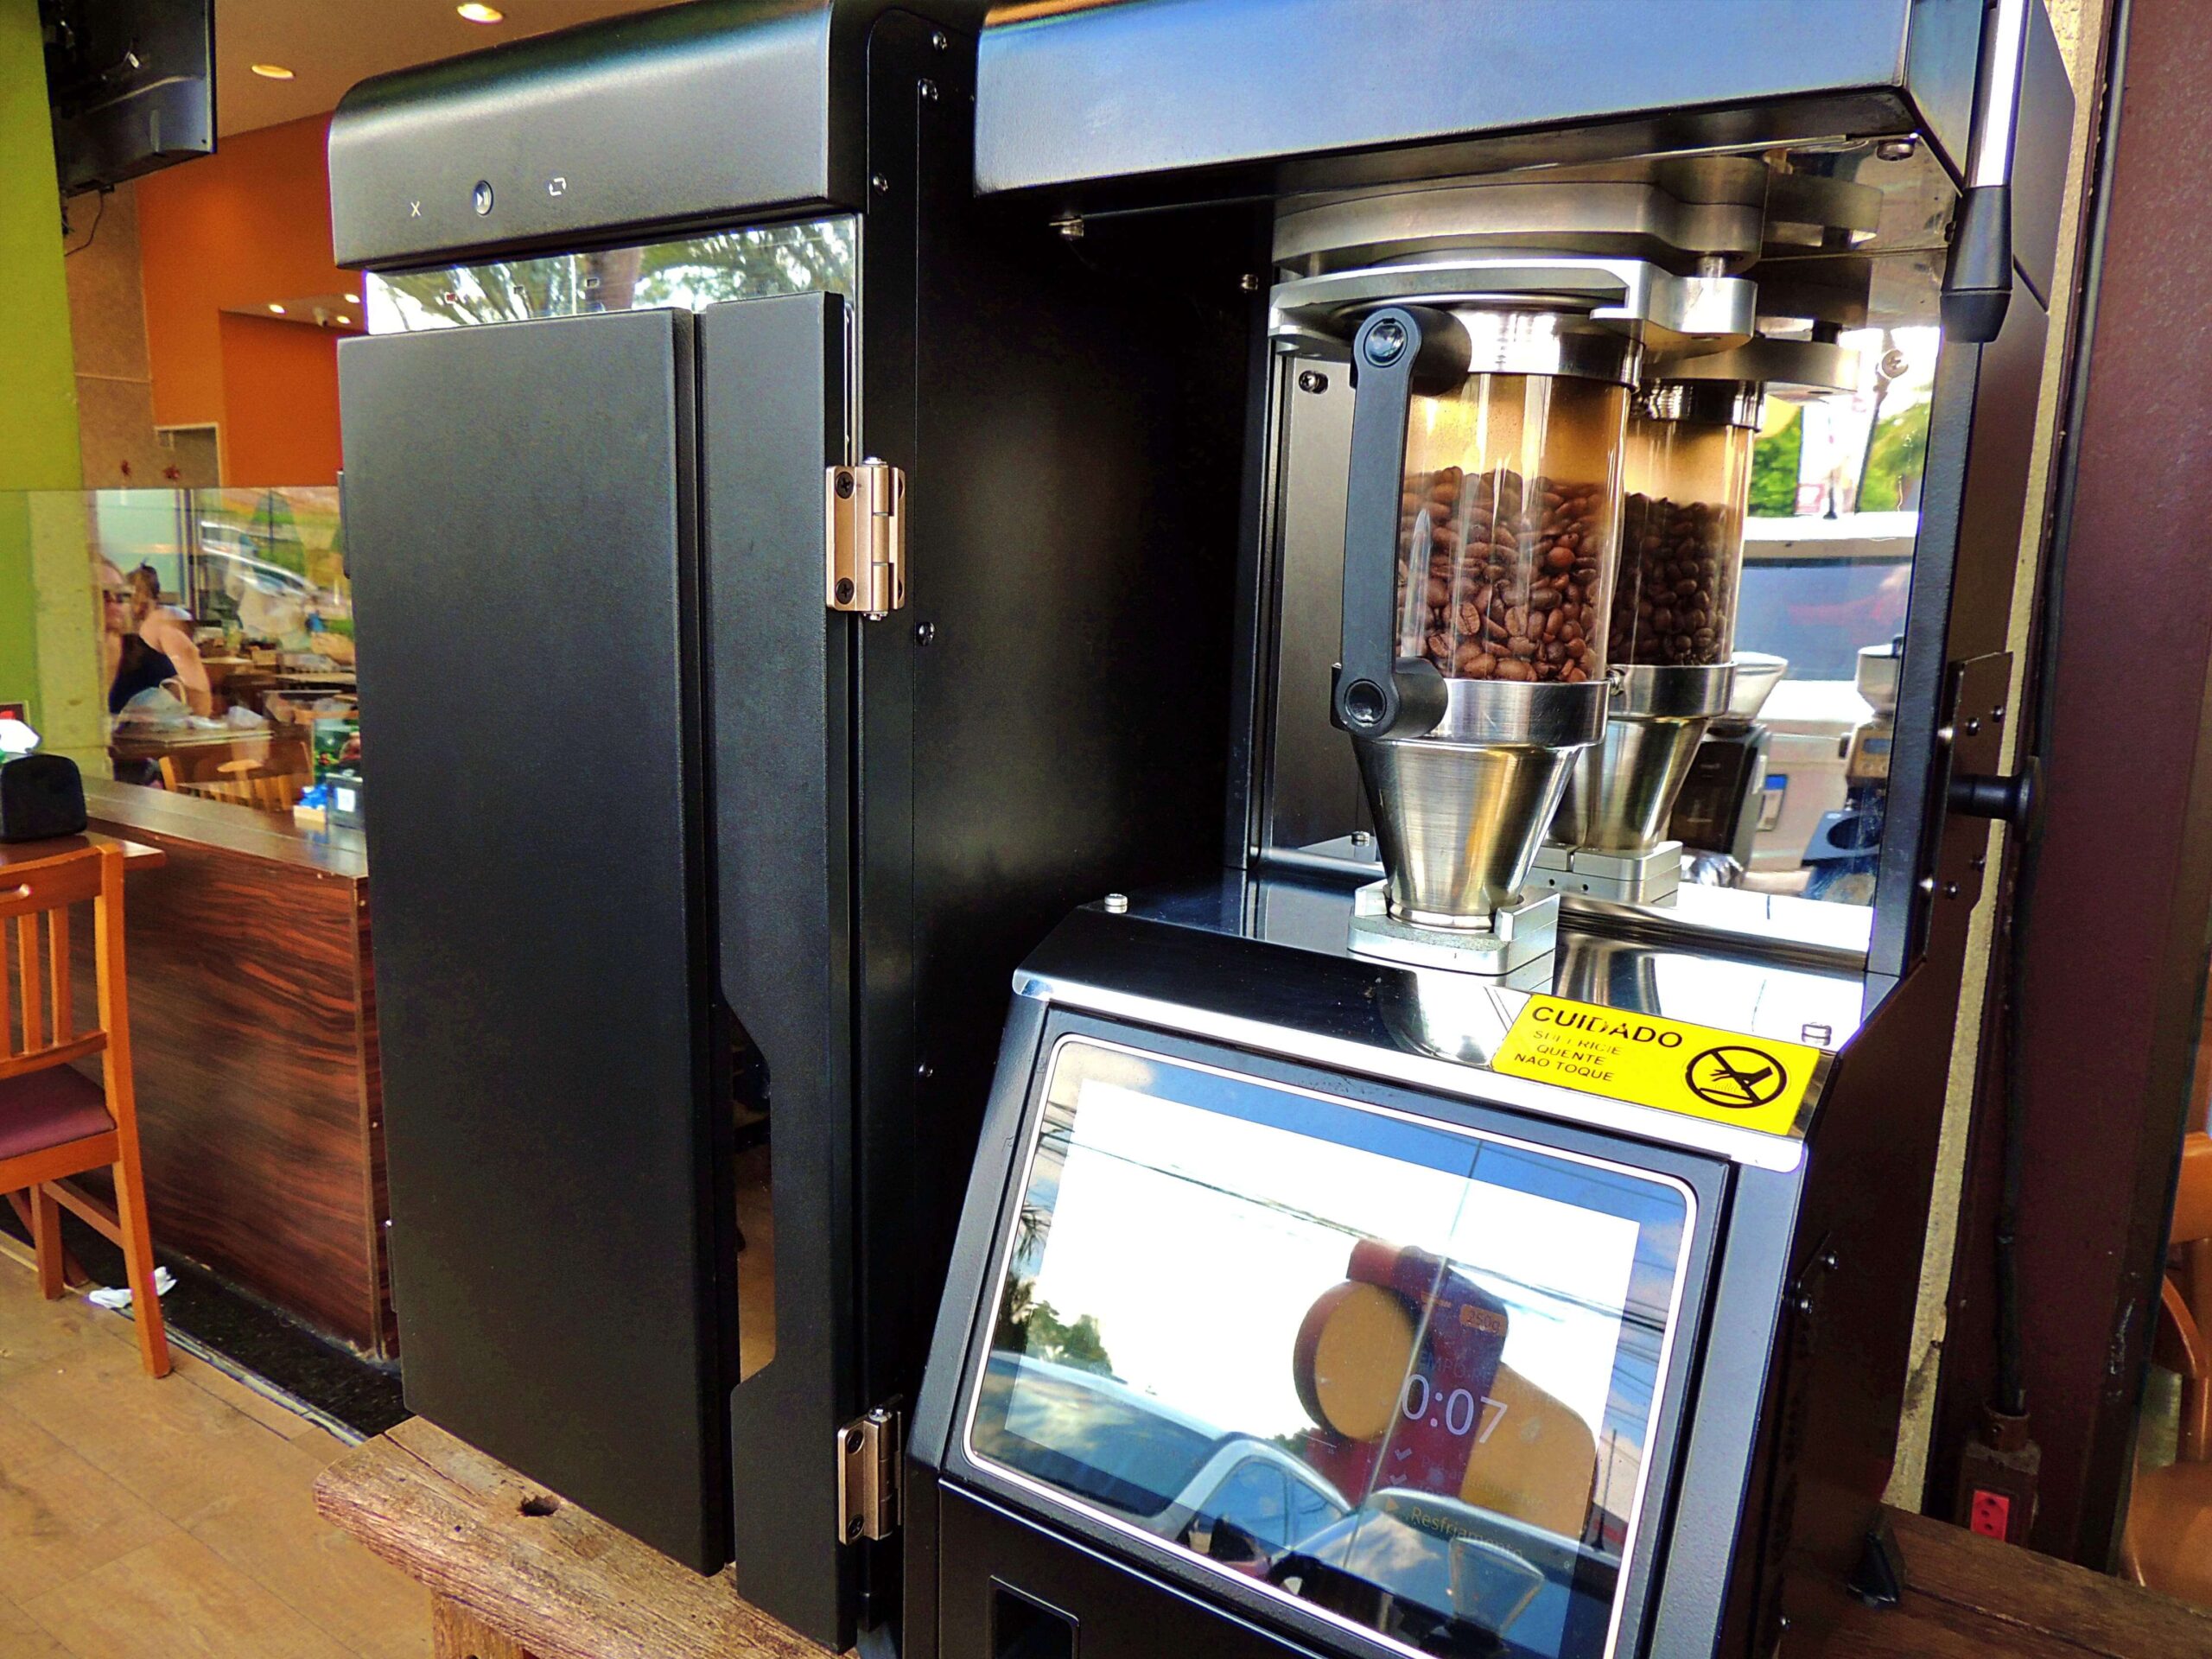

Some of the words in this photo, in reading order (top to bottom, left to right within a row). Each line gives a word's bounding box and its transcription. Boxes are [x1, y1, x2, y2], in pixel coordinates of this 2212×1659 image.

[1532, 1007, 1683, 1048] CUIDADO
[1514, 1053, 1550, 1068] NAO
[1555, 1061, 1615, 1082] TOQUE
[1536, 1044, 1607, 1065] QUENTE
[1465, 1308, 1501, 1334] 250g
[1402, 1374, 1508, 1444] 0:07
